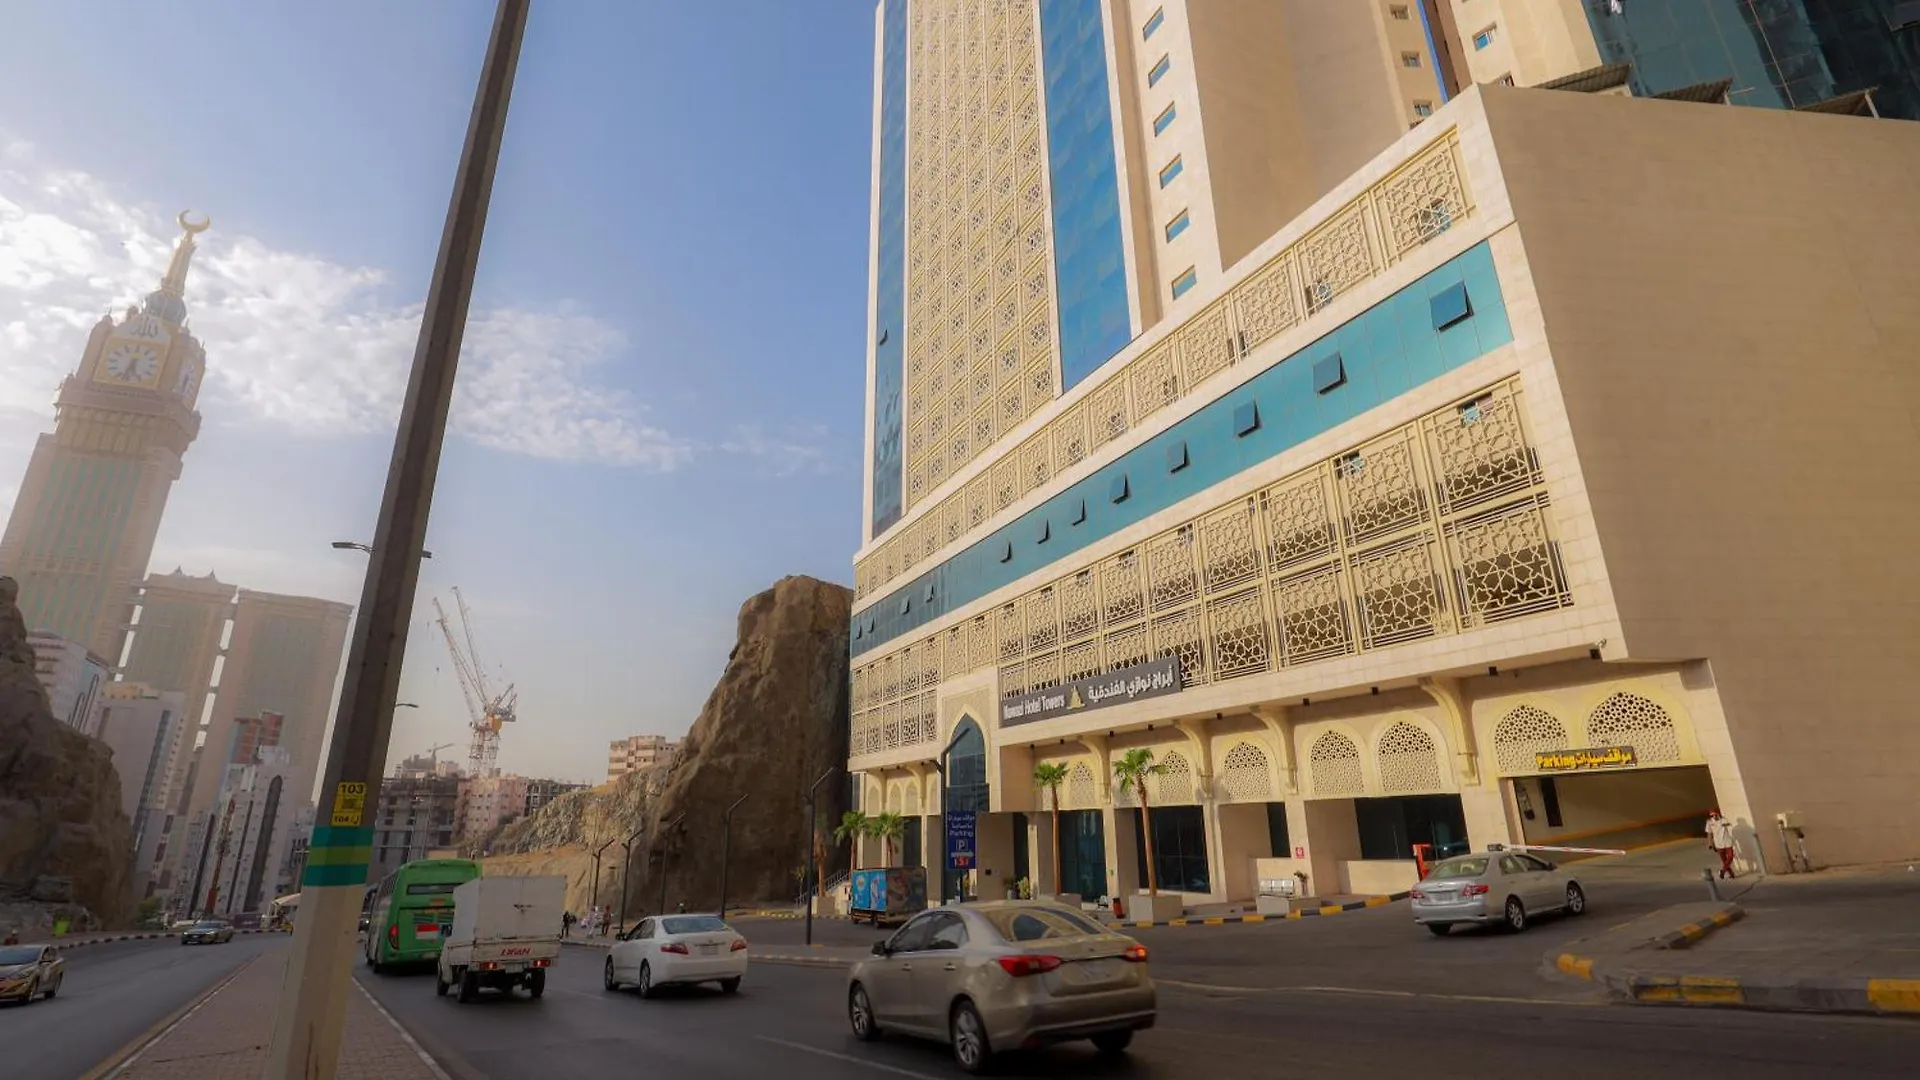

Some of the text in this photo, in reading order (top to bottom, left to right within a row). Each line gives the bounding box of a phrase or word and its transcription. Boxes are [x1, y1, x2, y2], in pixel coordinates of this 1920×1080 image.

[1152, 664, 1174, 689] أبراج
[1088, 680, 1126, 703] الفندقية
[1024, 696, 1042, 715] Hotel
[1041, 694, 1066, 711] Towers
[1536, 754, 1577, 770] Parking
[340, 783, 364, 794] 103
[334, 815, 349, 823] 104
